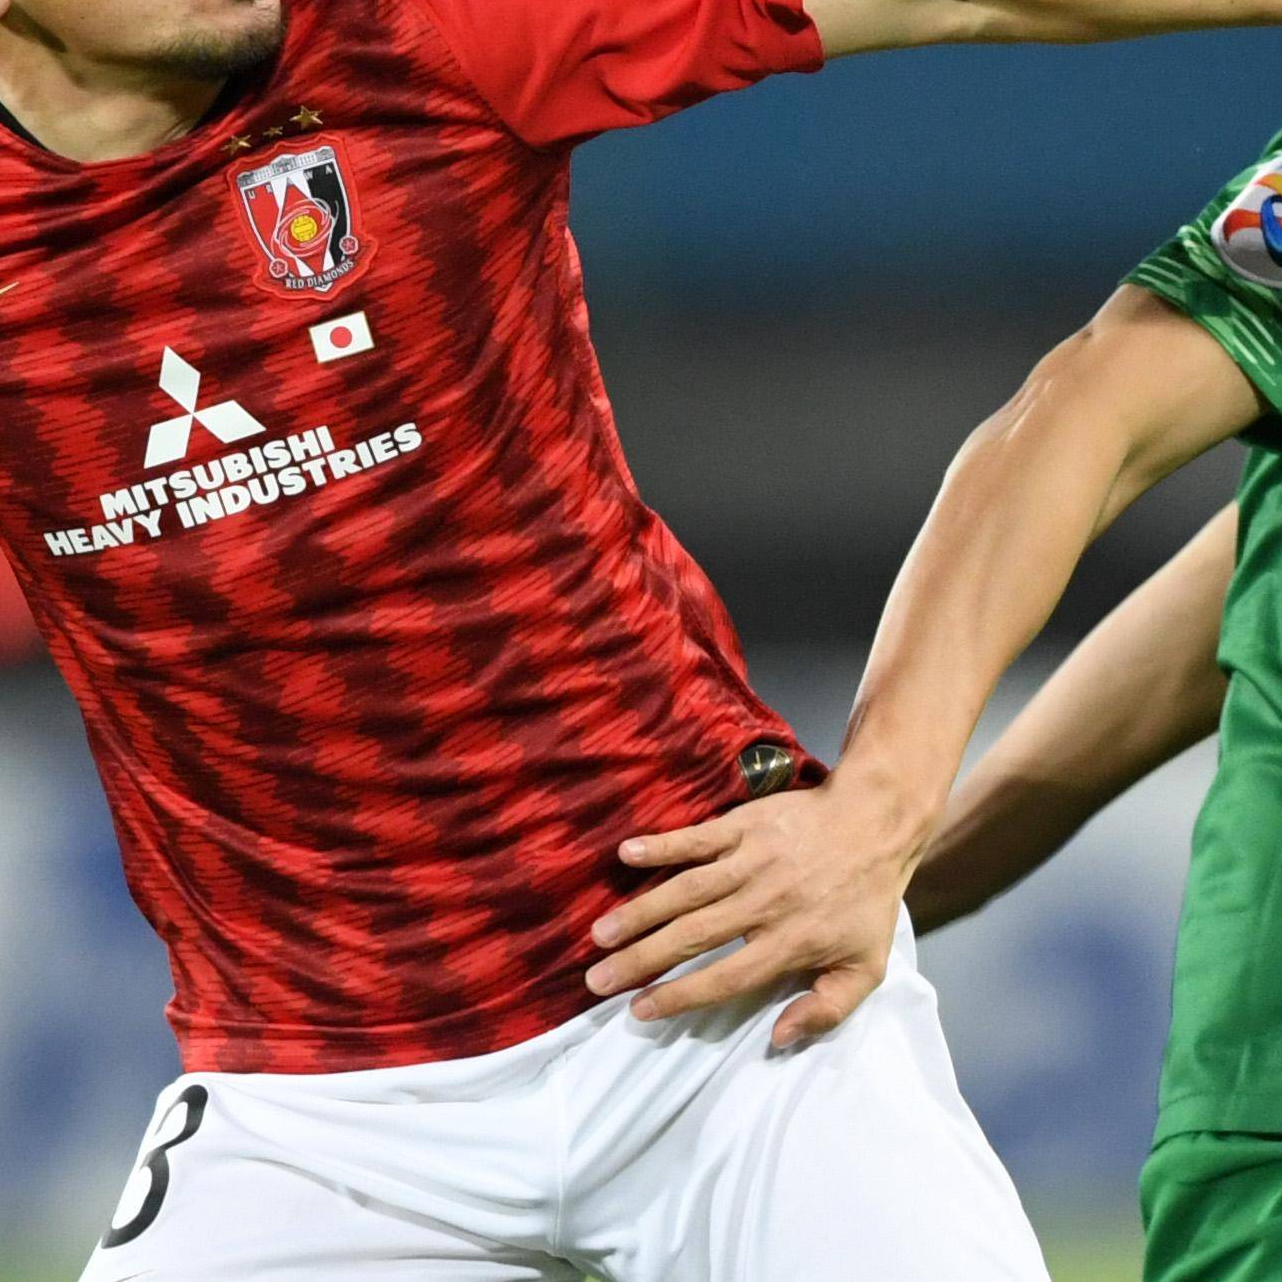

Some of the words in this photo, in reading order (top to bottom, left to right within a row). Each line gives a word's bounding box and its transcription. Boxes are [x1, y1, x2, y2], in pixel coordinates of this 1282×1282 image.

[285, 277, 305, 289] RED
[306, 259, 354, 287] DIAMONDS
[43, 508, 163, 556] HEAVY
[175, 422, 423, 529] INDUSTRIES
[99, 425, 336, 521] MITSUBISHI
[101, 1084, 209, 1249] 3
